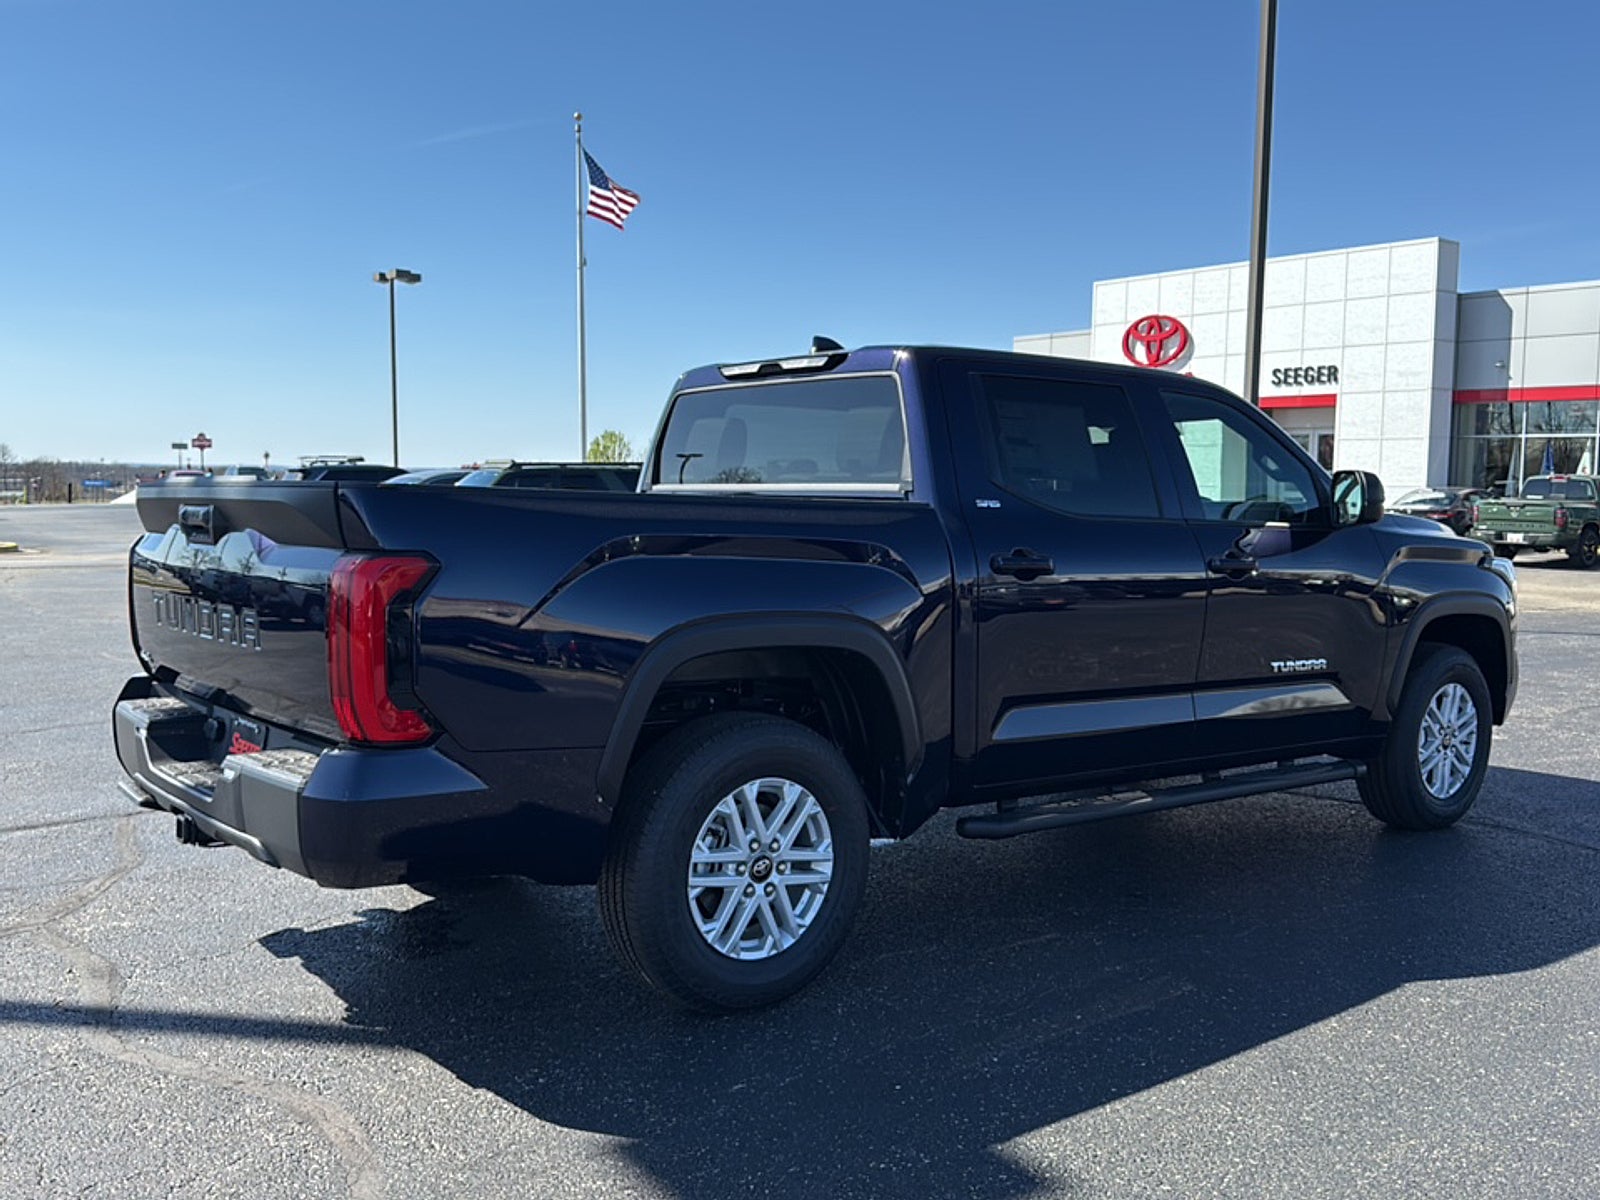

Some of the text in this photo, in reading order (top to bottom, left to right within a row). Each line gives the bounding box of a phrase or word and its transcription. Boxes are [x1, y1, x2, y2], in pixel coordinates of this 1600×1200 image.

[1271, 365, 1339, 387] SEEGER
[152, 590, 261, 651] TUNDRA
[1271, 658, 1327, 673] TUNDRA
